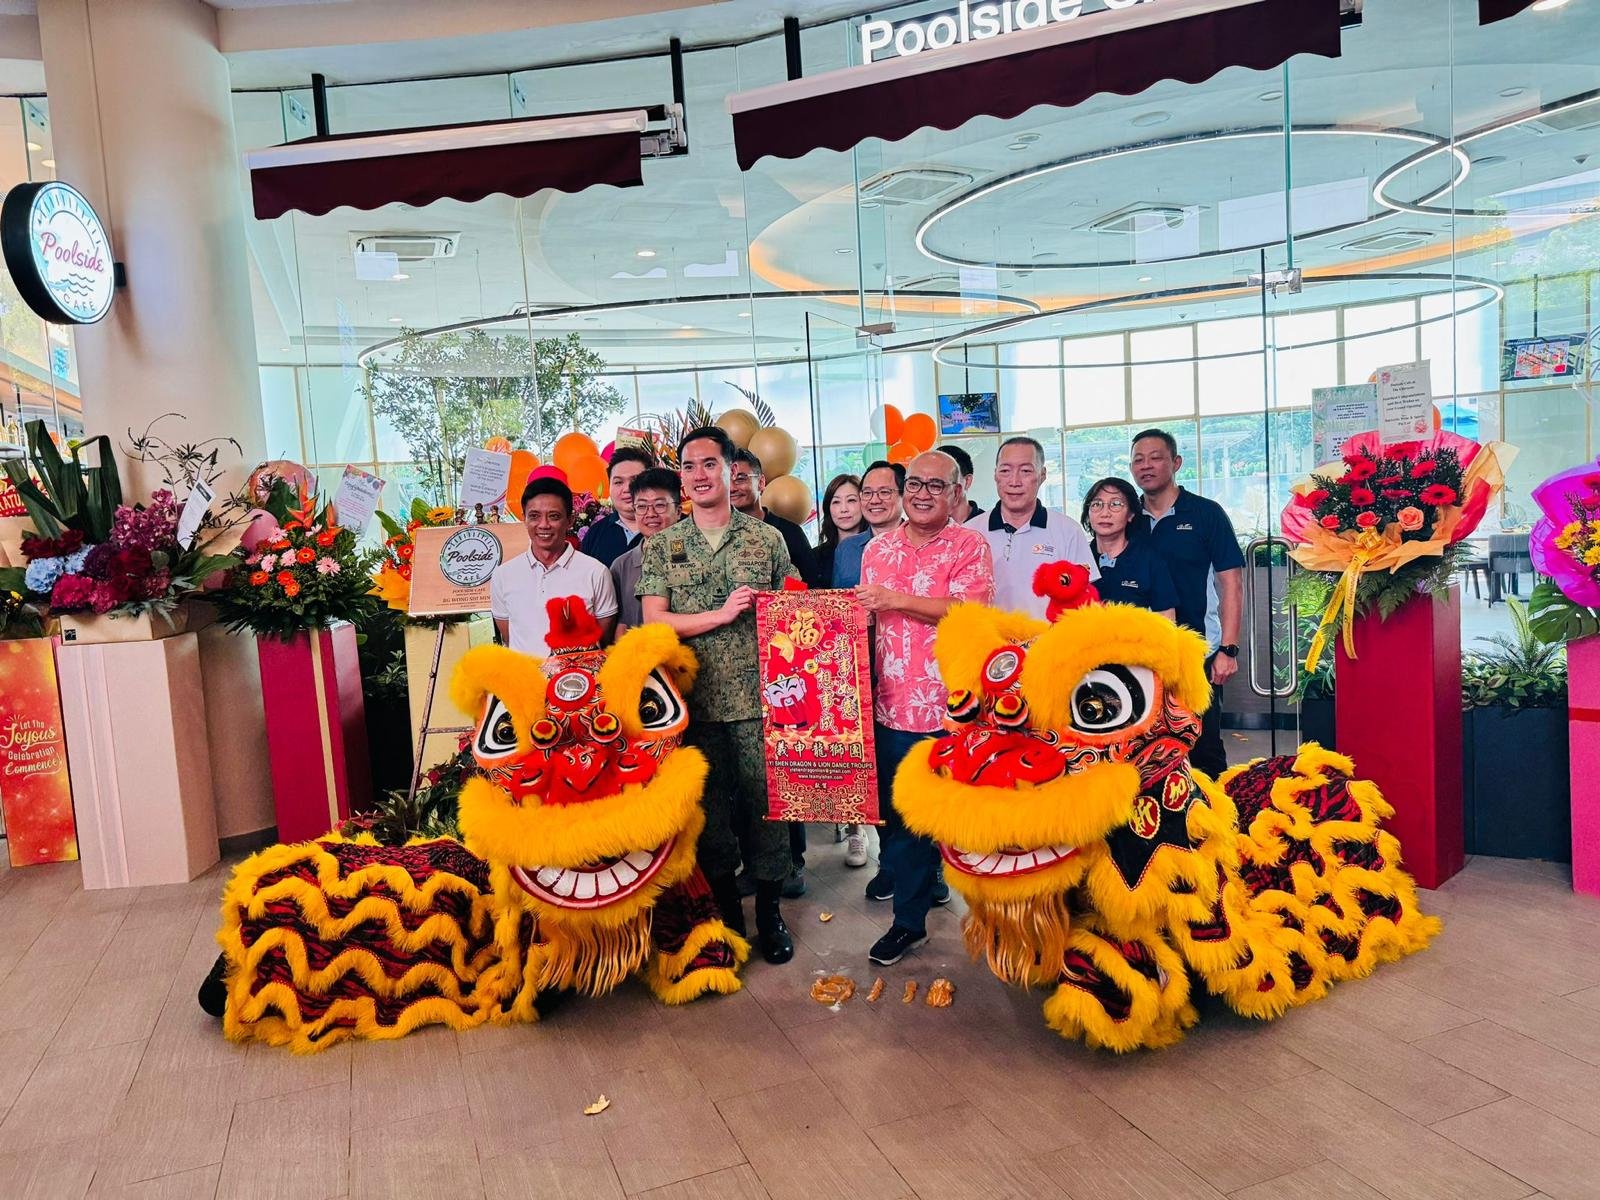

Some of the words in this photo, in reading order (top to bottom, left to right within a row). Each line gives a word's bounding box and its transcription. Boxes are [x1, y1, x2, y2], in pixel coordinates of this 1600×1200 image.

[861, 0, 1083, 64] Poolside
[41, 231, 104, 272] Poolside
[447, 548, 494, 563] Poolside
[788, 607, 821, 646] 福
[20, 722, 31, 730] Let
[0, 723, 61, 751] Joyous
[8, 746, 55, 760] Celebration
[775, 760, 789, 768] SHEN
